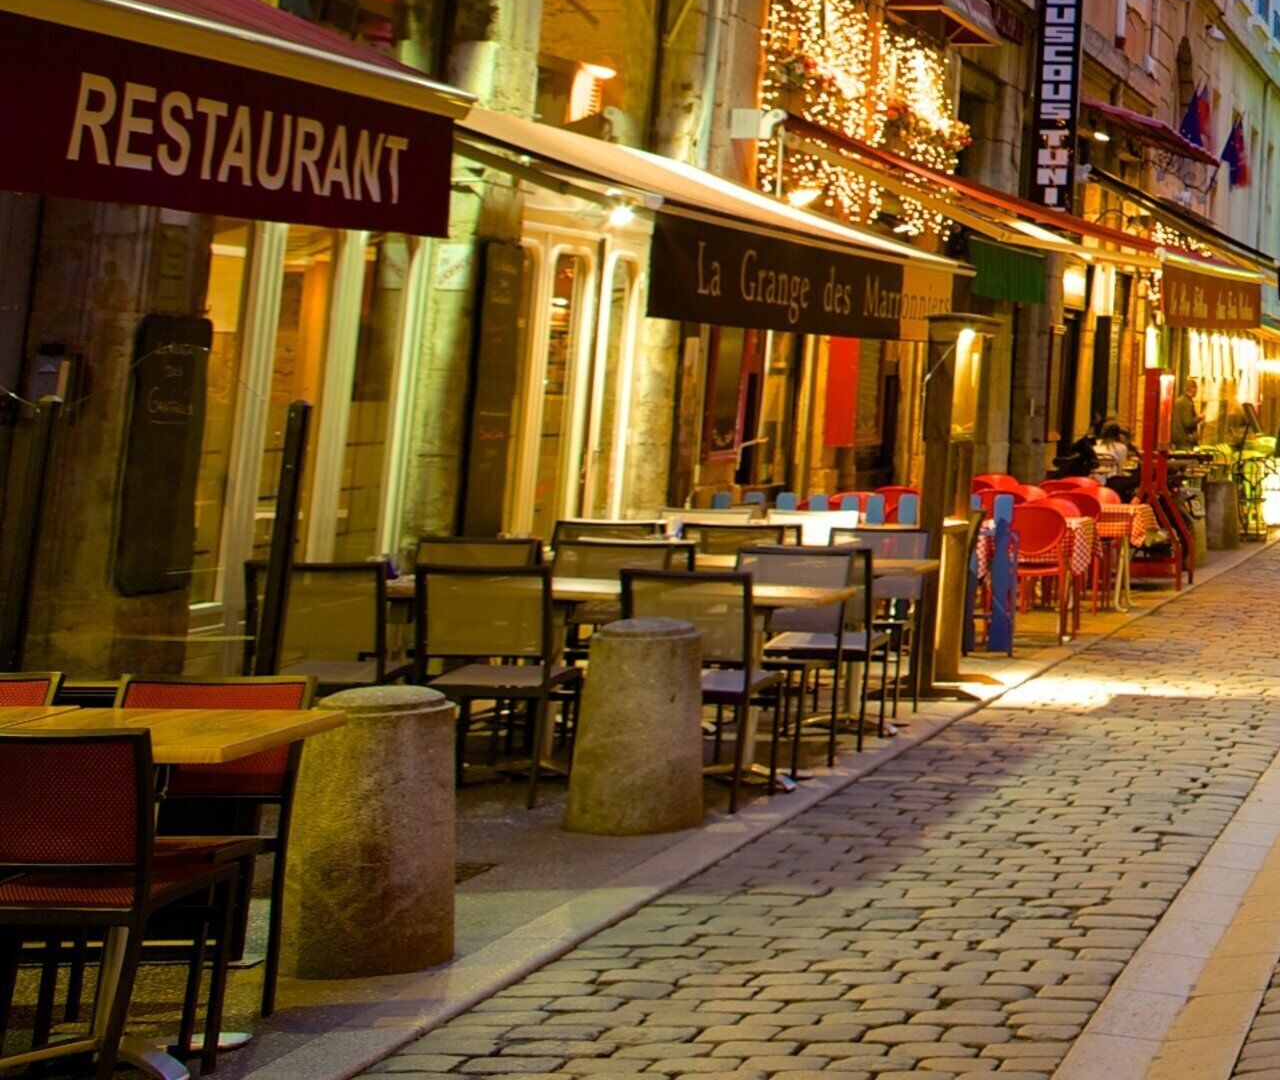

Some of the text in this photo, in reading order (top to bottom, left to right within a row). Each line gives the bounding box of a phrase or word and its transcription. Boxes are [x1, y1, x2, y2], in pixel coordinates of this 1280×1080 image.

[66, 72, 408, 204] RESTAURANT
[1037, 129, 1069, 211] TUNI
[696, 241, 951, 323] La Grange des Marronniers
